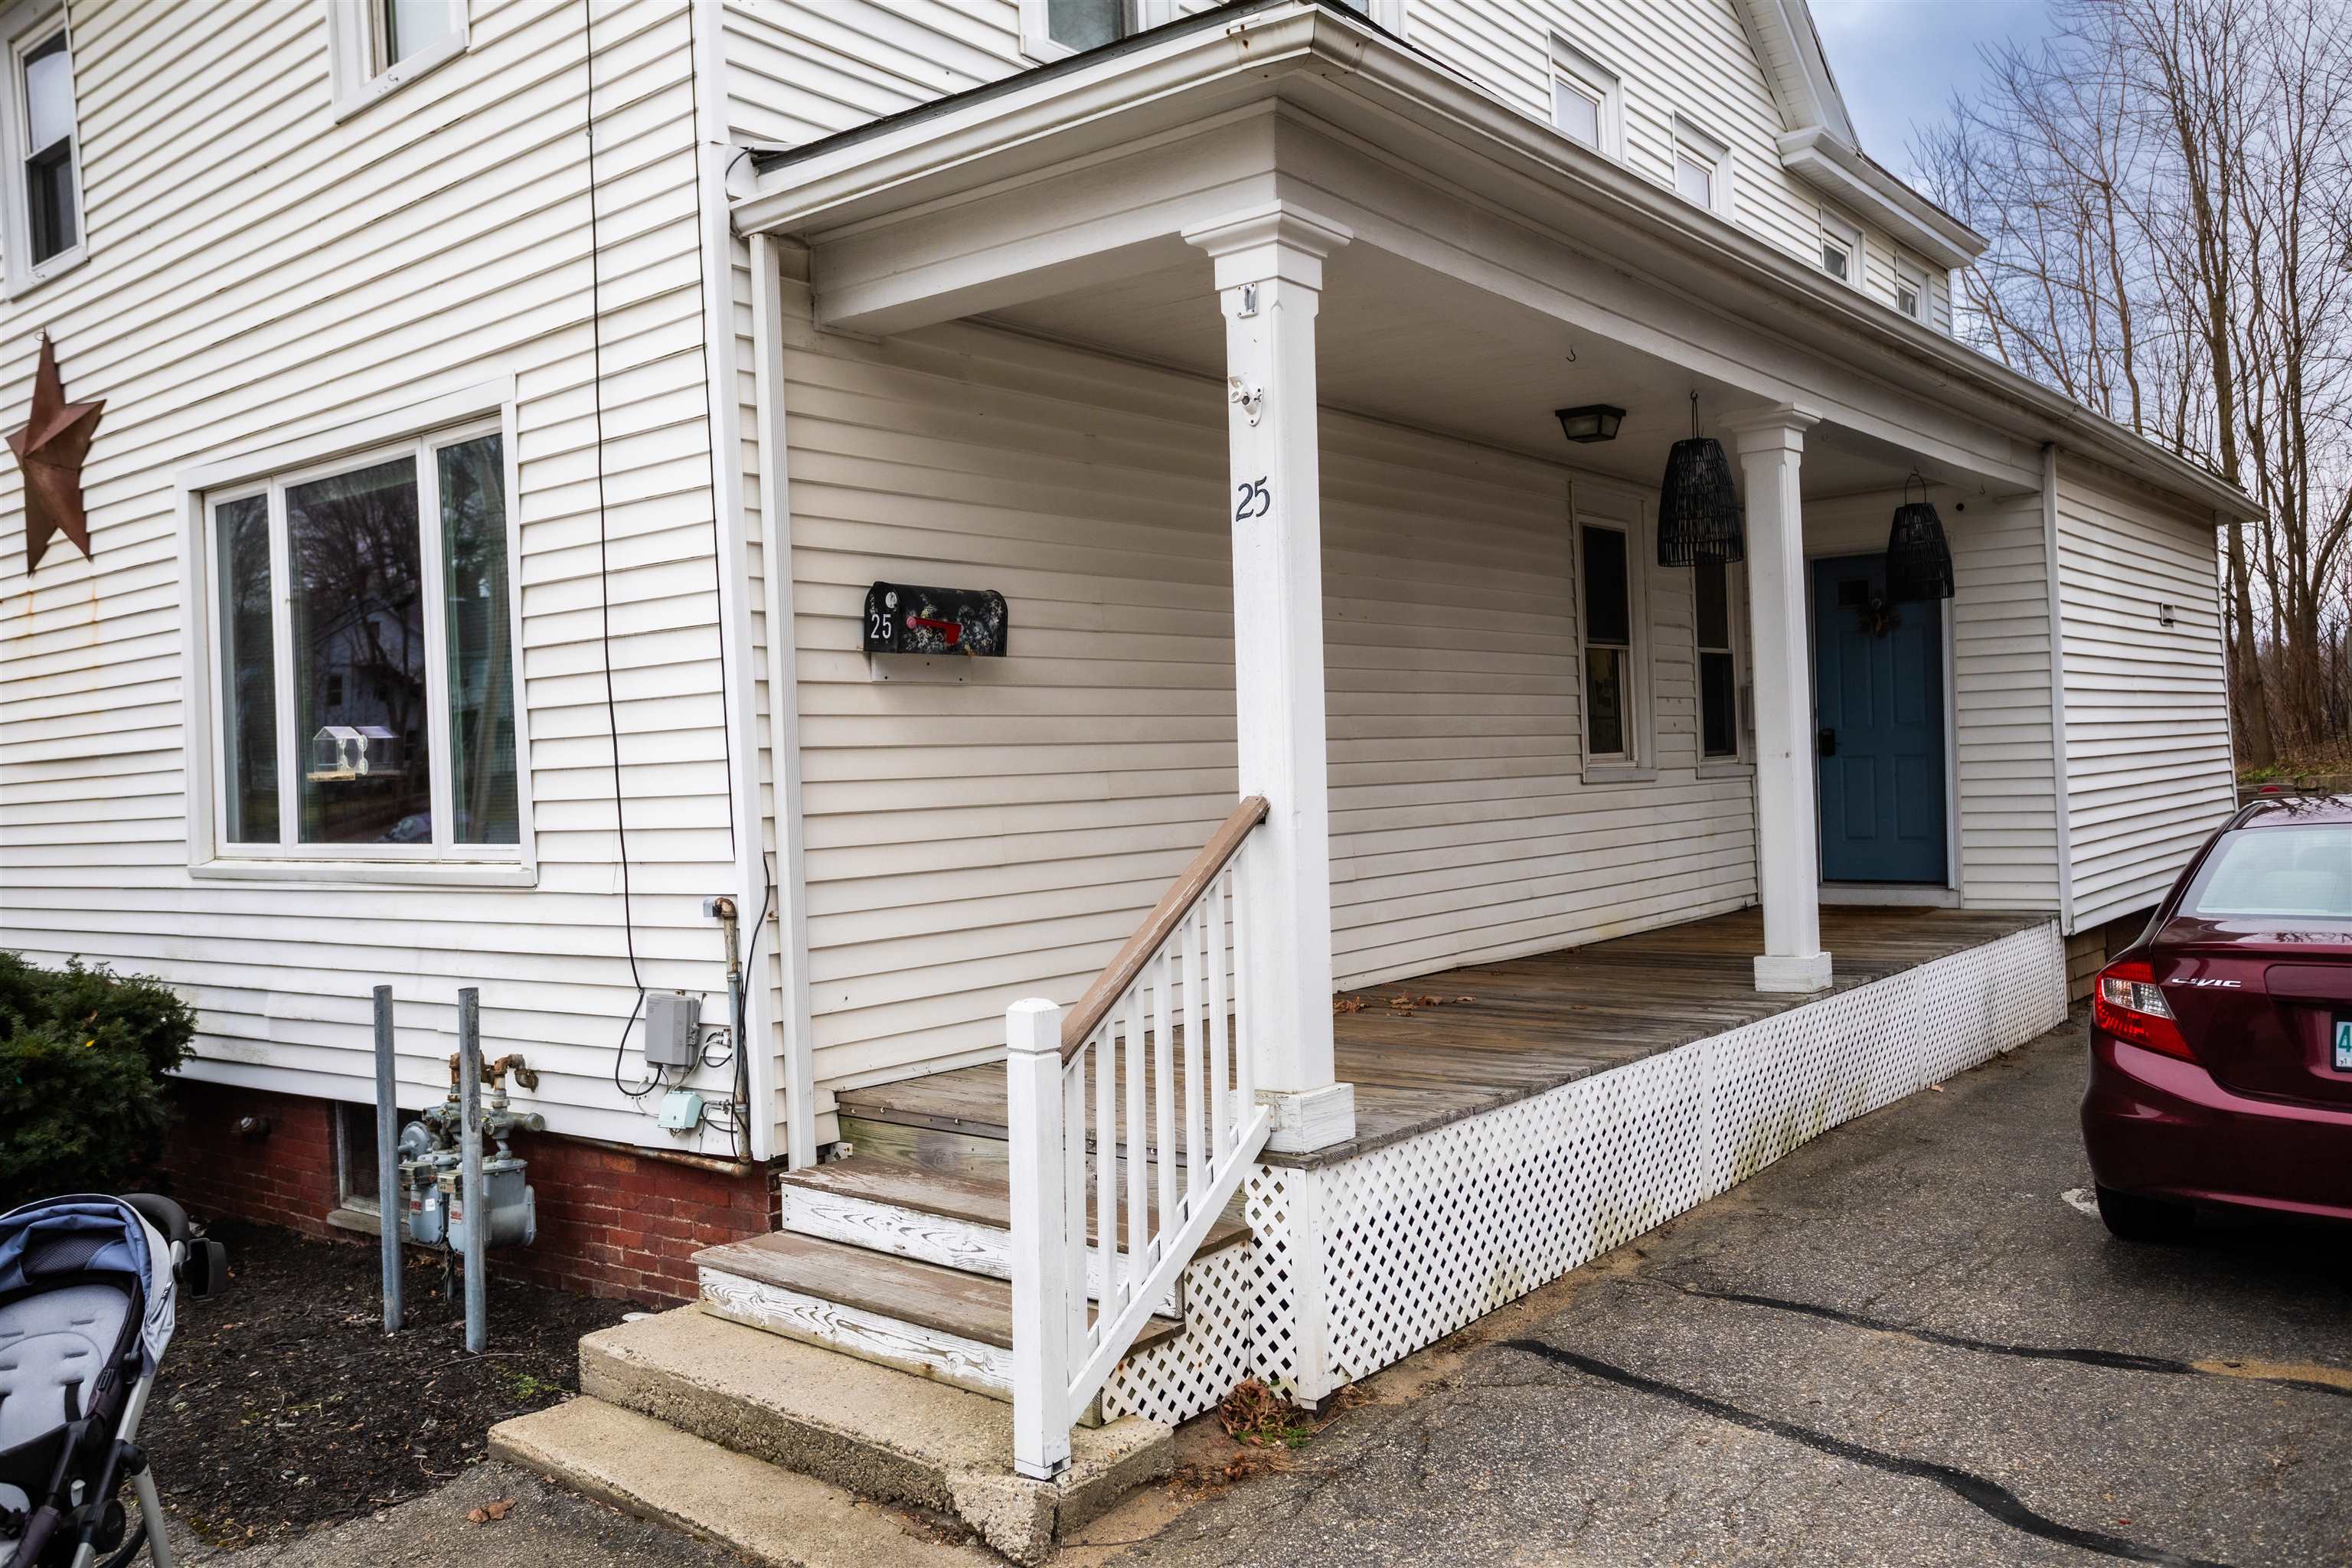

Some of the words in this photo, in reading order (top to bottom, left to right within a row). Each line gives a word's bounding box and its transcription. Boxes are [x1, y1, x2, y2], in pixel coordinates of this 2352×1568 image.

[1236, 475, 1270, 522] 25
[871, 613, 891, 639] 25
[2171, 978, 2242, 988] CIVIC
